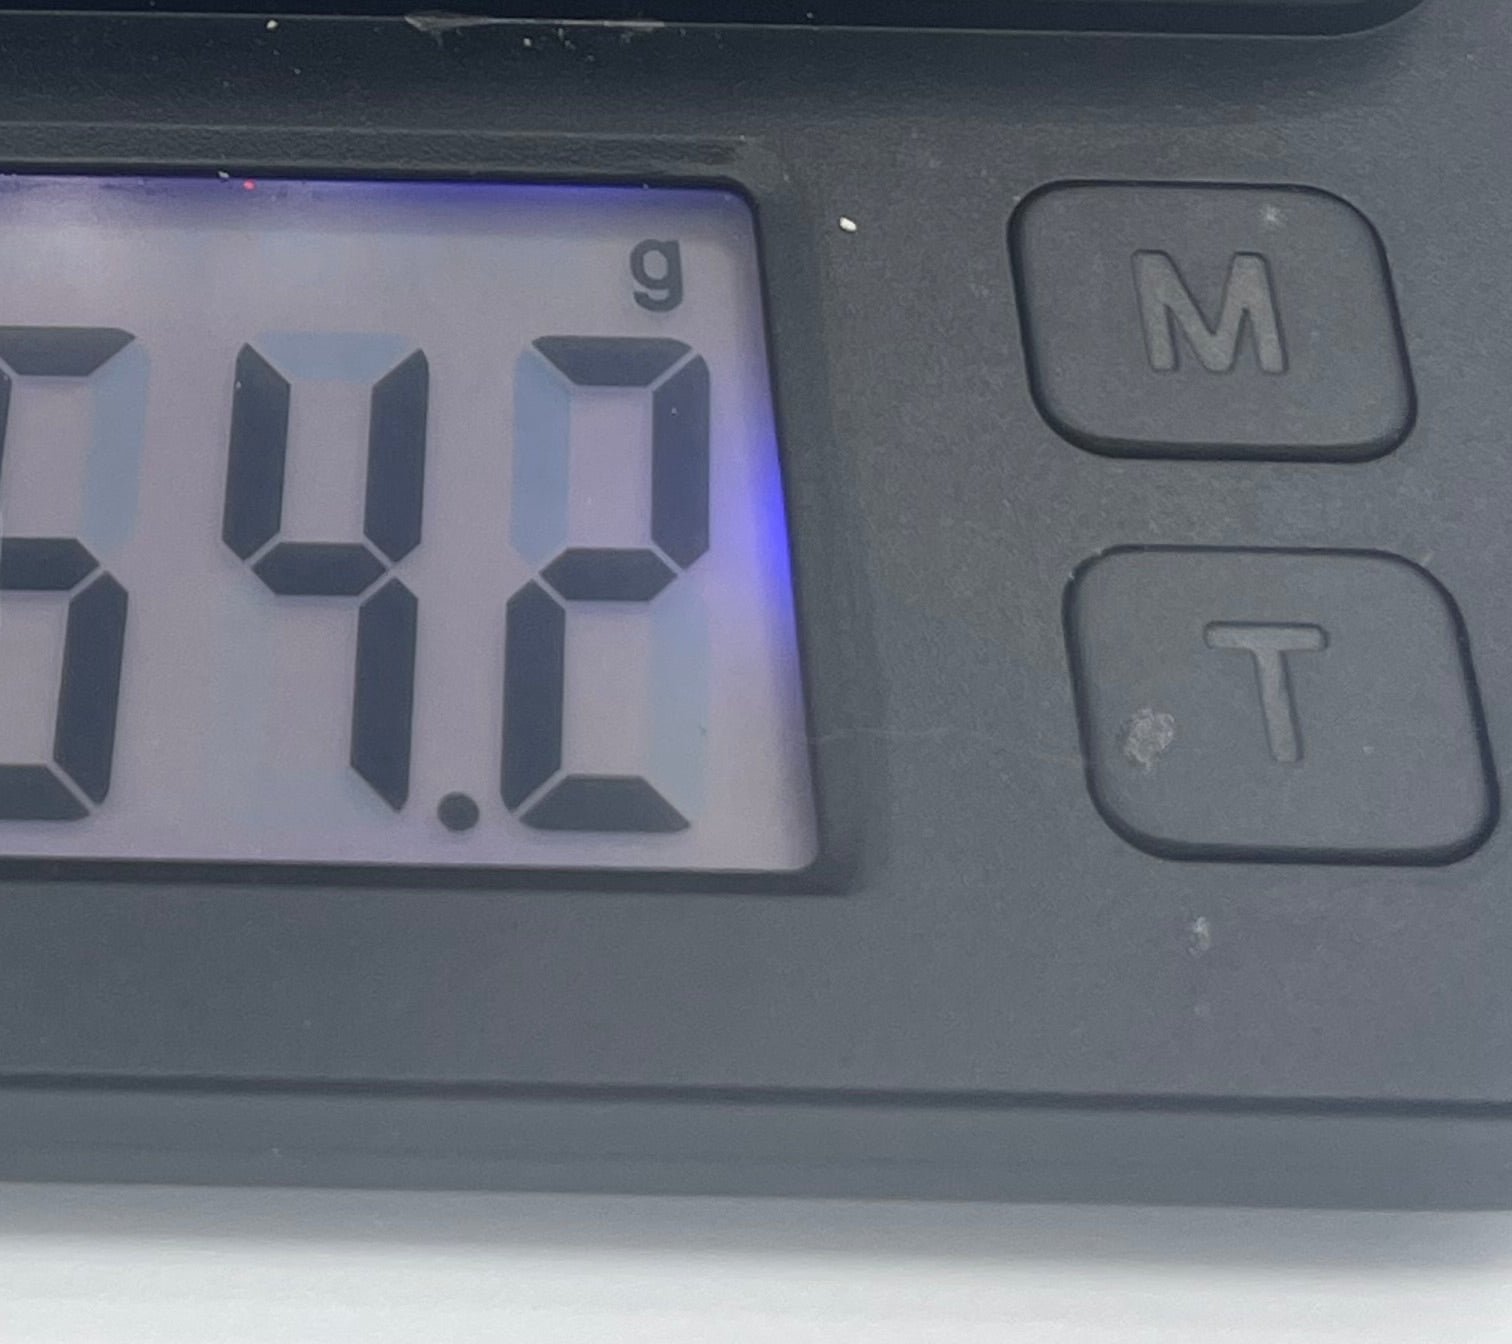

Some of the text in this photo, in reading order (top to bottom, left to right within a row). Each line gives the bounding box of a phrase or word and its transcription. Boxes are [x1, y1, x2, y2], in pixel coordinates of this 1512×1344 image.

[629, 238, 684, 312] g
[1130, 248, 1288, 376] M
[1203, 620, 1329, 764] T
